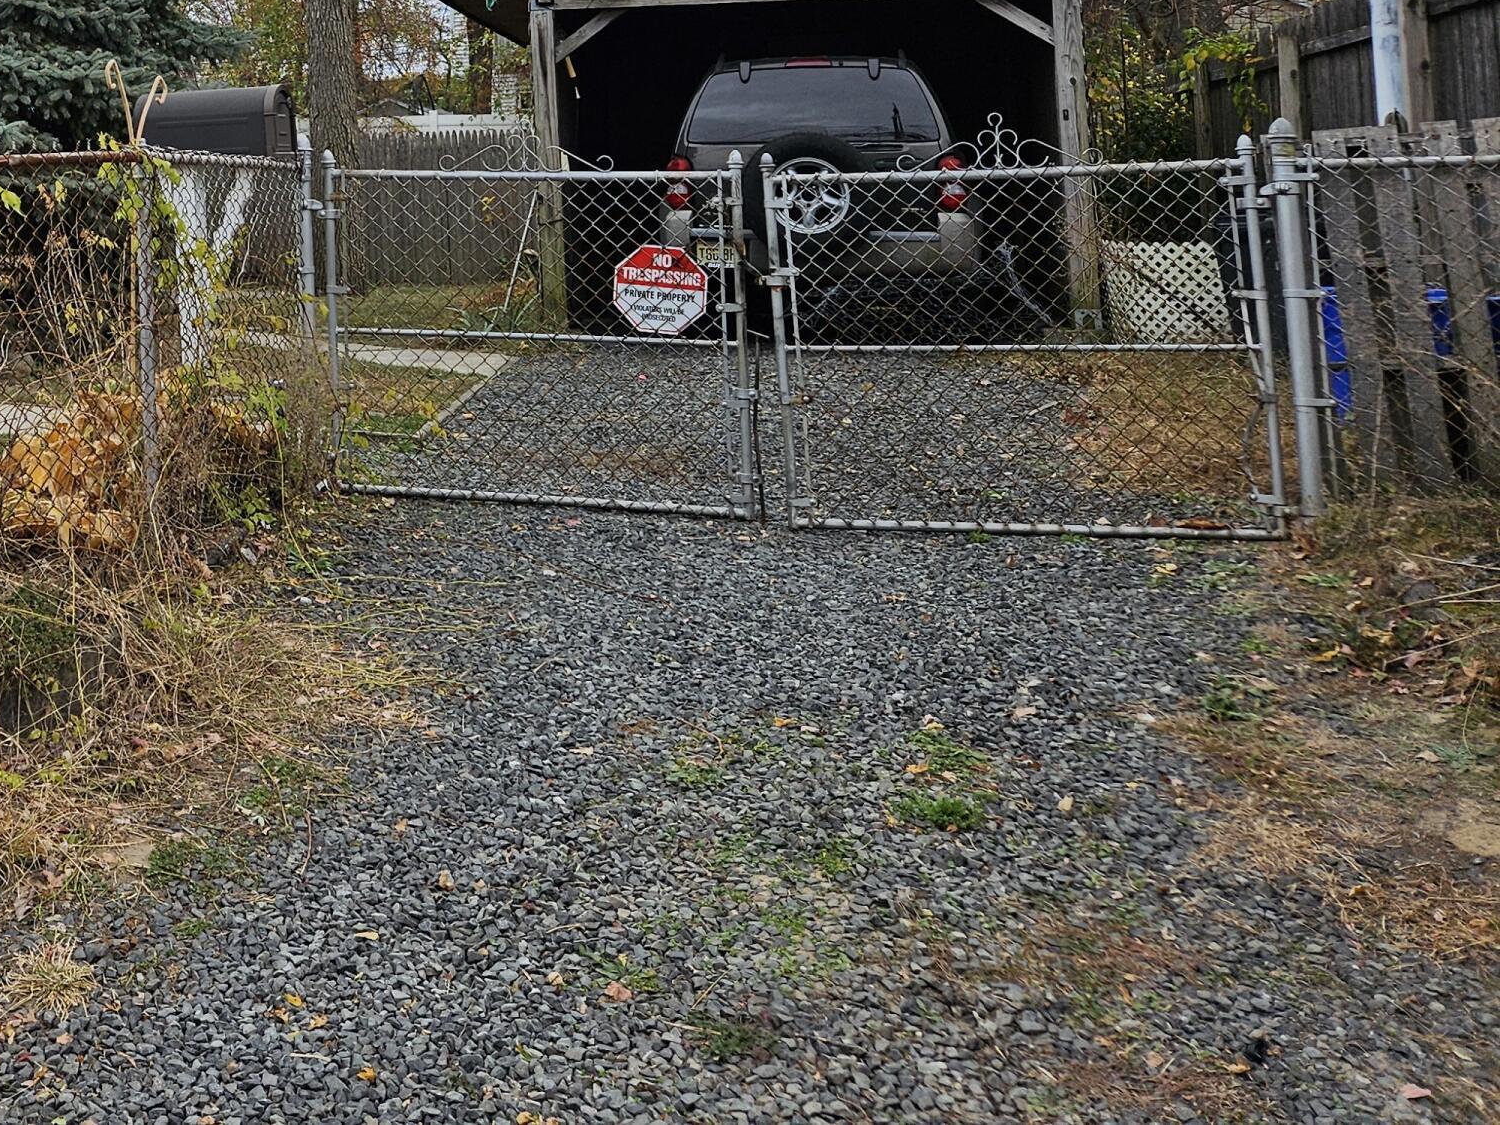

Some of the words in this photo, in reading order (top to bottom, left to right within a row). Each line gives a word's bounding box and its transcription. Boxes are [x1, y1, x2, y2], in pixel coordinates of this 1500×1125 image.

[653, 253, 672, 268] NO
[622, 266, 702, 287] TRESPASSING
[624, 288, 655, 300] PRIVATE
[657, 291, 696, 303] PROPERTY
